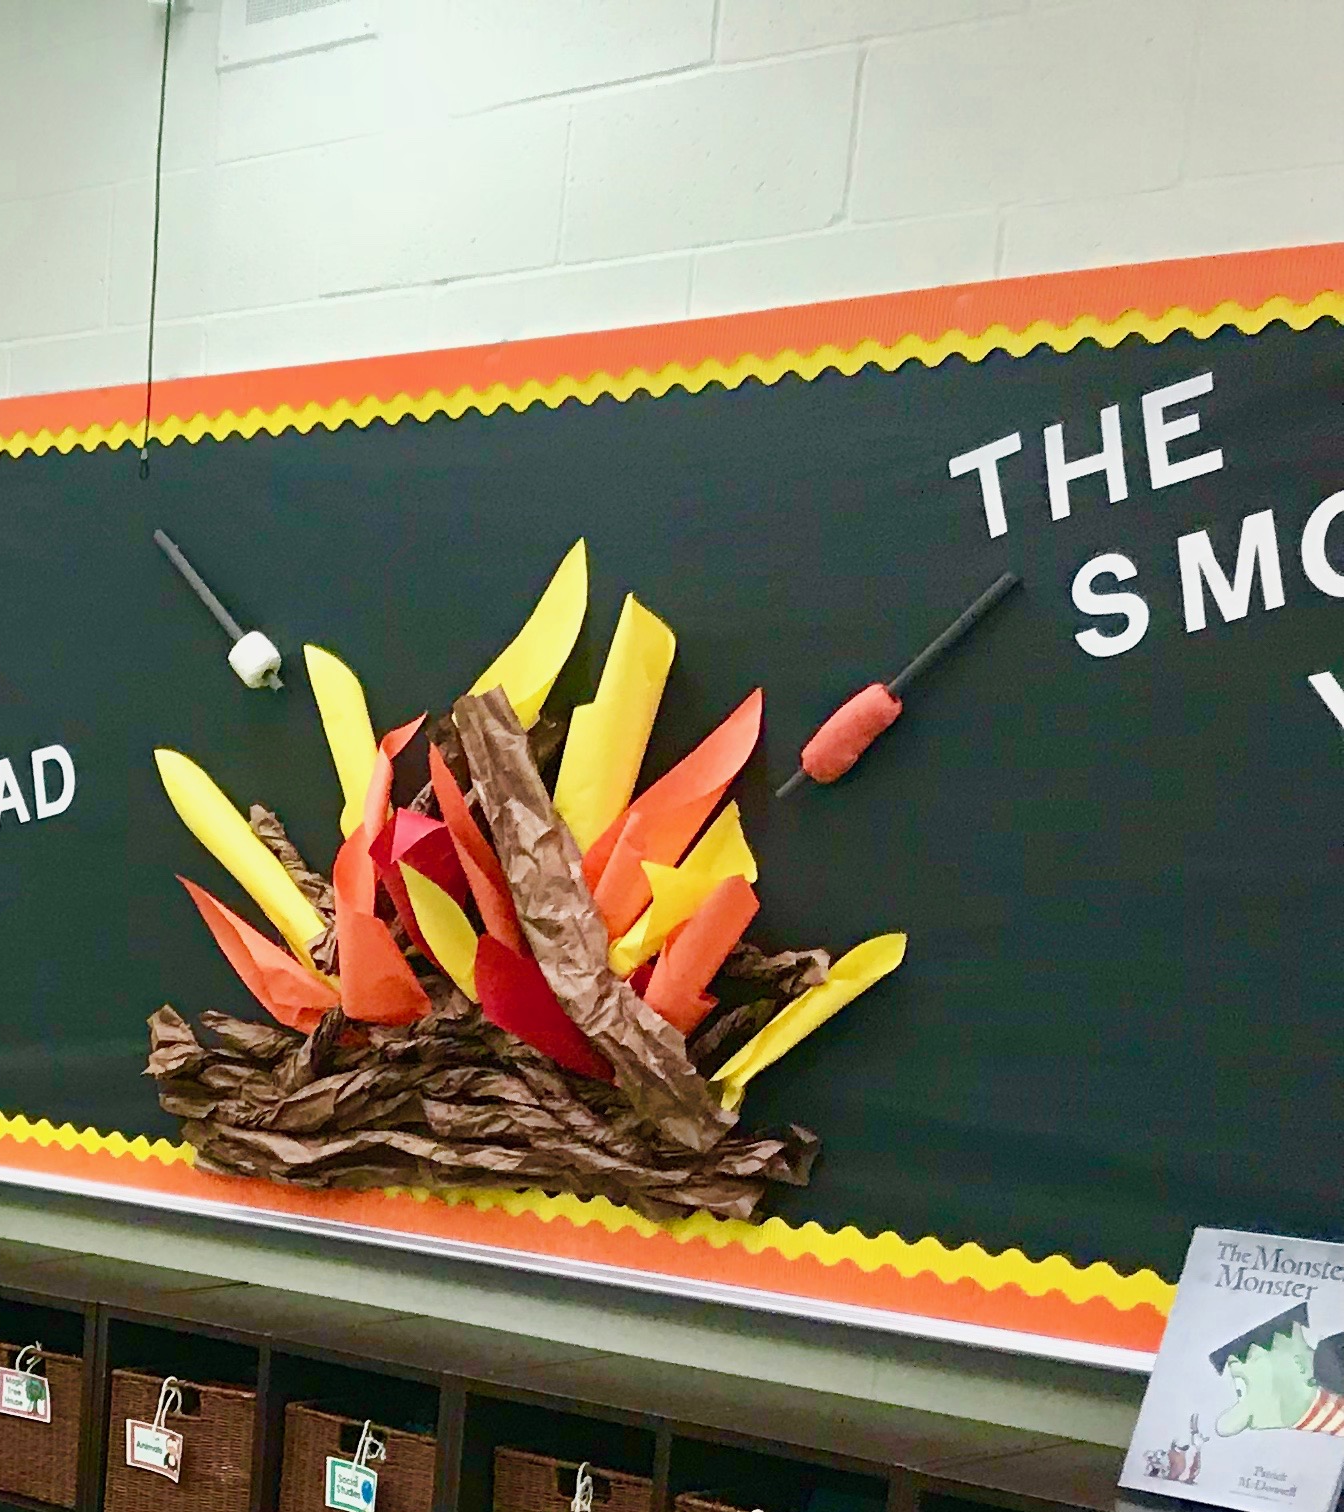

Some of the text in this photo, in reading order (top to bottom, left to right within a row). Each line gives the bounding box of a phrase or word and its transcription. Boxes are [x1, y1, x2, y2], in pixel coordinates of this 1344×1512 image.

[948, 371, 1224, 539] THE
[1217, 1240, 1251, 1264] The
[1215, 1264, 1318, 1300] Monster
[136, 1440, 163, 1455] Animals
[337, 1473, 359, 1488] Social
